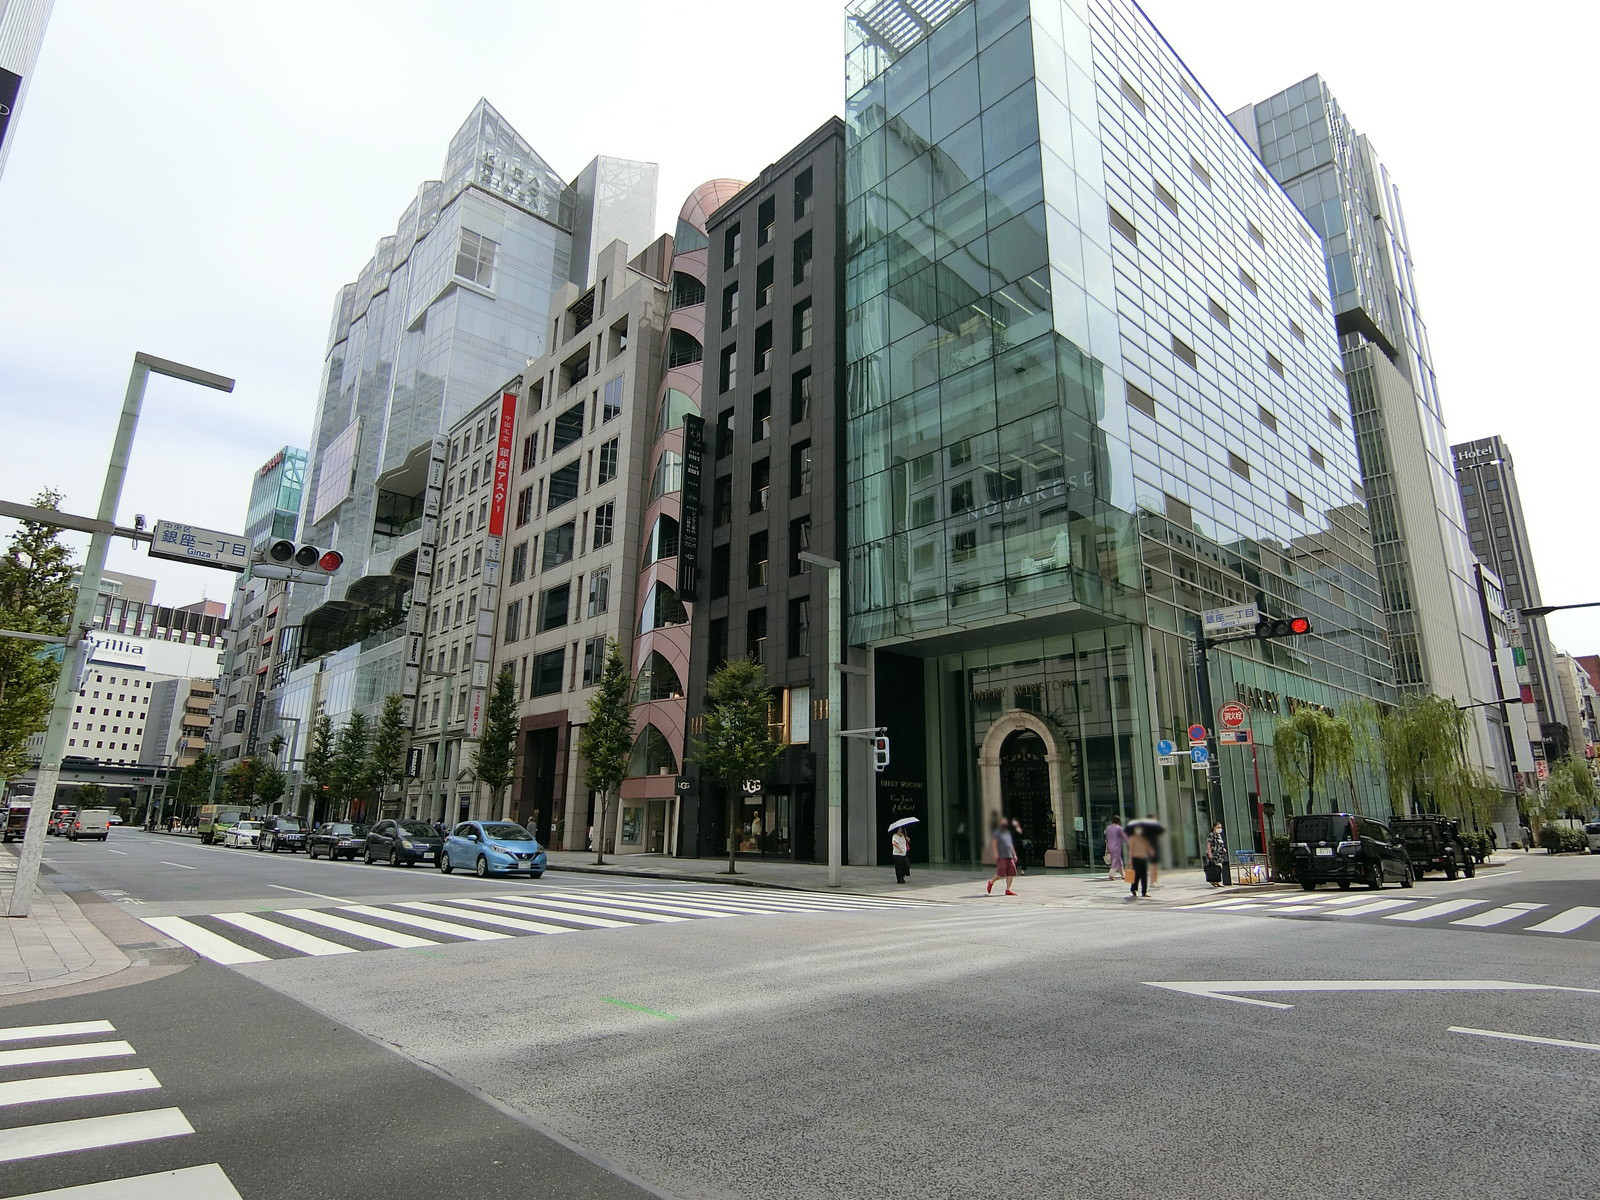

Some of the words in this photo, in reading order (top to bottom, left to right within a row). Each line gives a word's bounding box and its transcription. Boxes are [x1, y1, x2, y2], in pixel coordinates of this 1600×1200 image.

[1458, 445, 1492, 460] Hotel
[495, 447, 510, 513] 銀座アスター
[967, 471, 1093, 521] NOVARESE
[164, 522, 191, 533] 中央区
[161, 530, 246, 557] 銀座一丁目
[187, 547, 211, 558] Ginza
[1205, 608, 1254, 623] 銀座一丁目
[970, 686, 1007, 700] HARRY
[1013, 679, 1070, 696] WINSTON
[1235, 682, 1280, 714] HARRY
[1224, 711, 1242, 721] 消火栓
[678, 781, 690, 790] UGG
[743, 779, 761, 793] UGG
